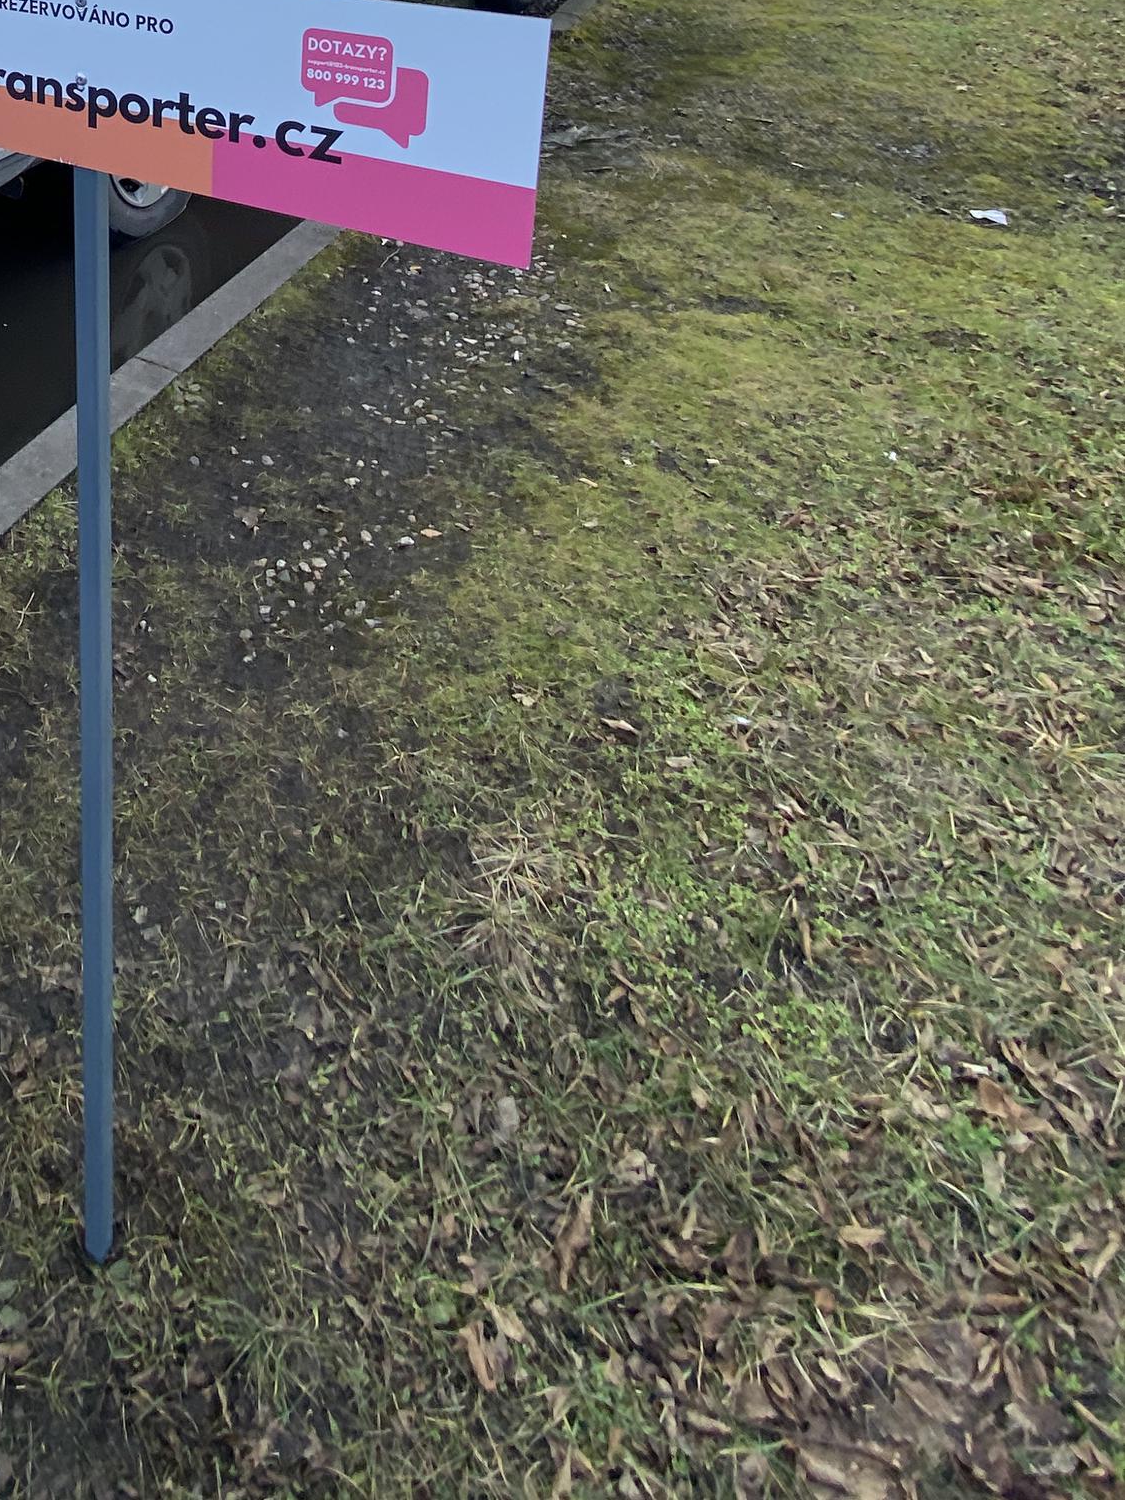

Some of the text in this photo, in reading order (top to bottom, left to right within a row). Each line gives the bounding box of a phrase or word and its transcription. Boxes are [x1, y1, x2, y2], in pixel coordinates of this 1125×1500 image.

[135, 14, 175, 35] PRO
[307, 36, 388, 61] DOTAZY?
[306, 68, 386, 90] 800 999 123
